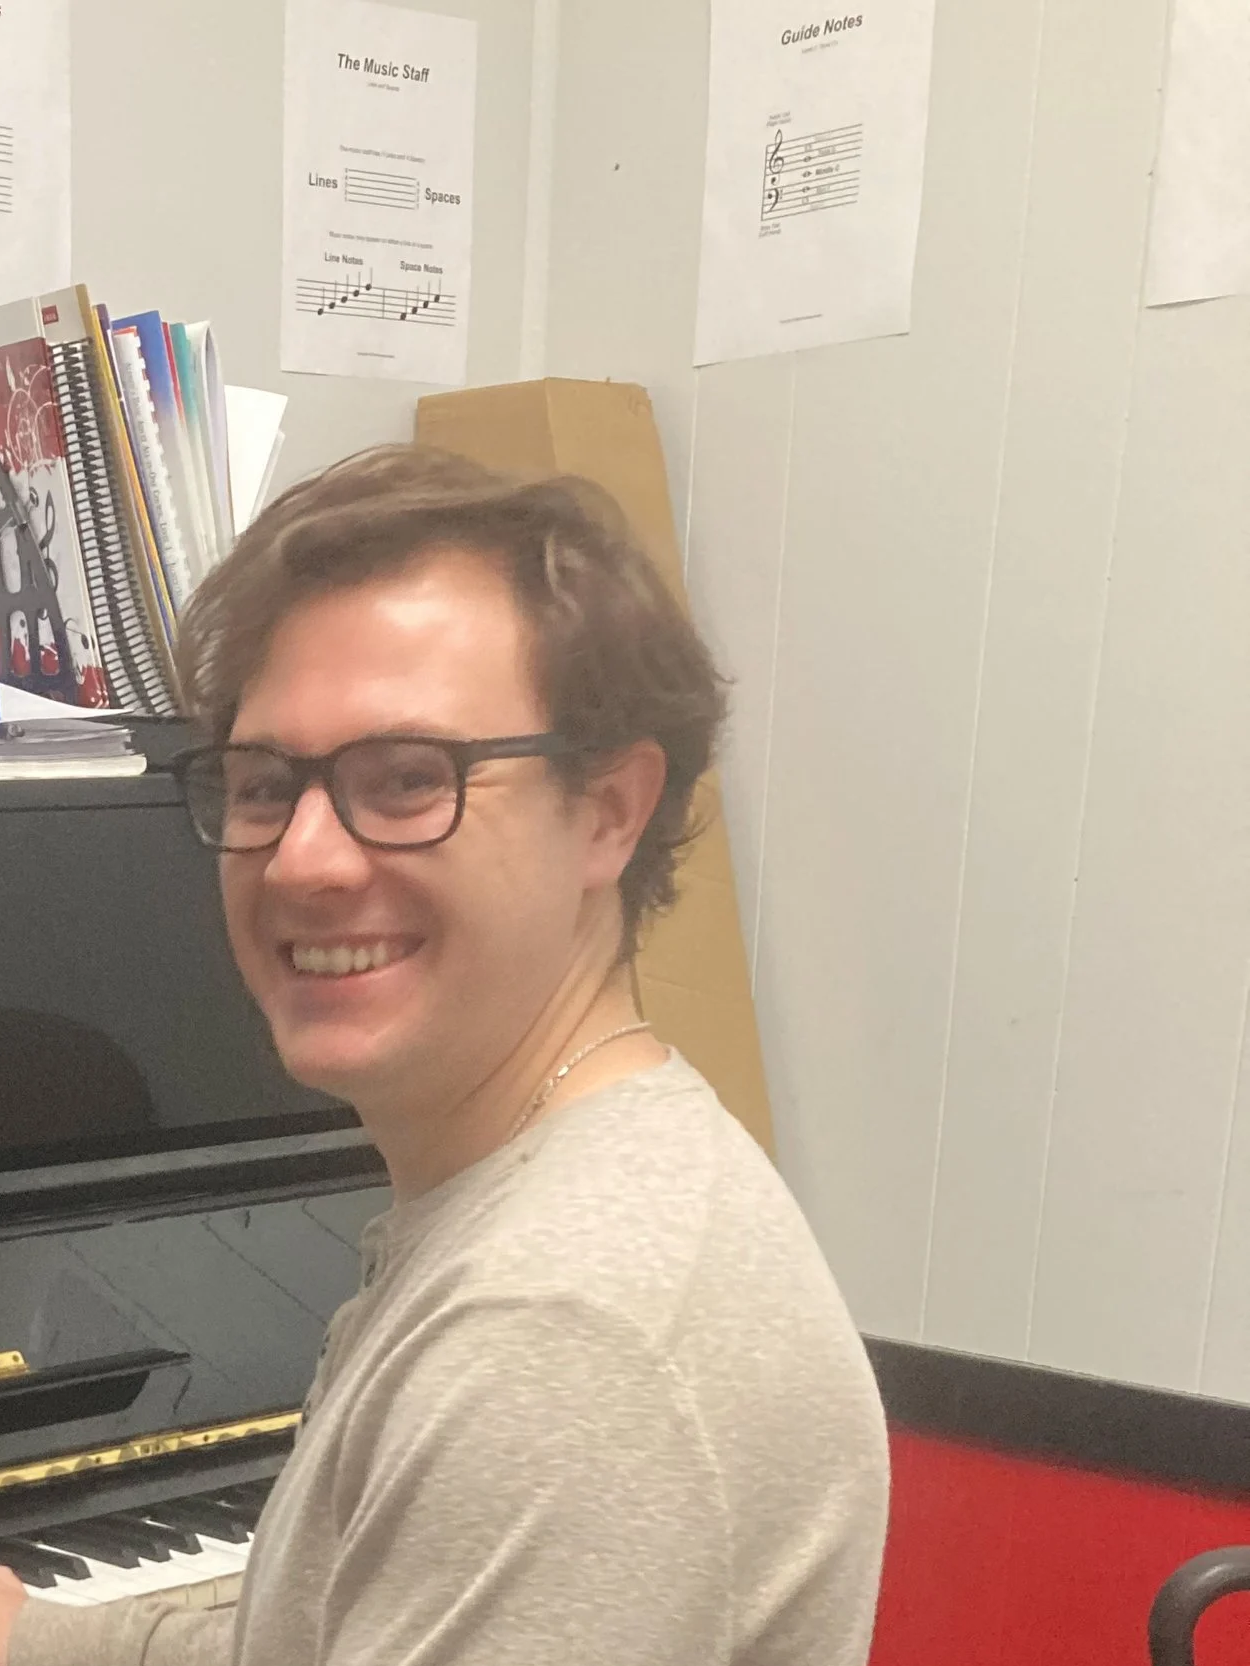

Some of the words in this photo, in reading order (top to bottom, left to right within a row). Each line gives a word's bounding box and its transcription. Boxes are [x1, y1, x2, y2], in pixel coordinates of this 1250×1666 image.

[781, 23, 820, 46] Guide
[823, 14, 863, 36] Notes
[337, 53, 360, 71] The
[363, 57, 399, 77] Music
[402, 64, 430, 83] Staff
[308, 172, 338, 189] Lines
[424, 188, 461, 205] Spaces
[324, 251, 340, 263] Line
[342, 254, 364, 266] Notes
[400, 260, 421, 272] Space
[423, 263, 443, 275] Notes
